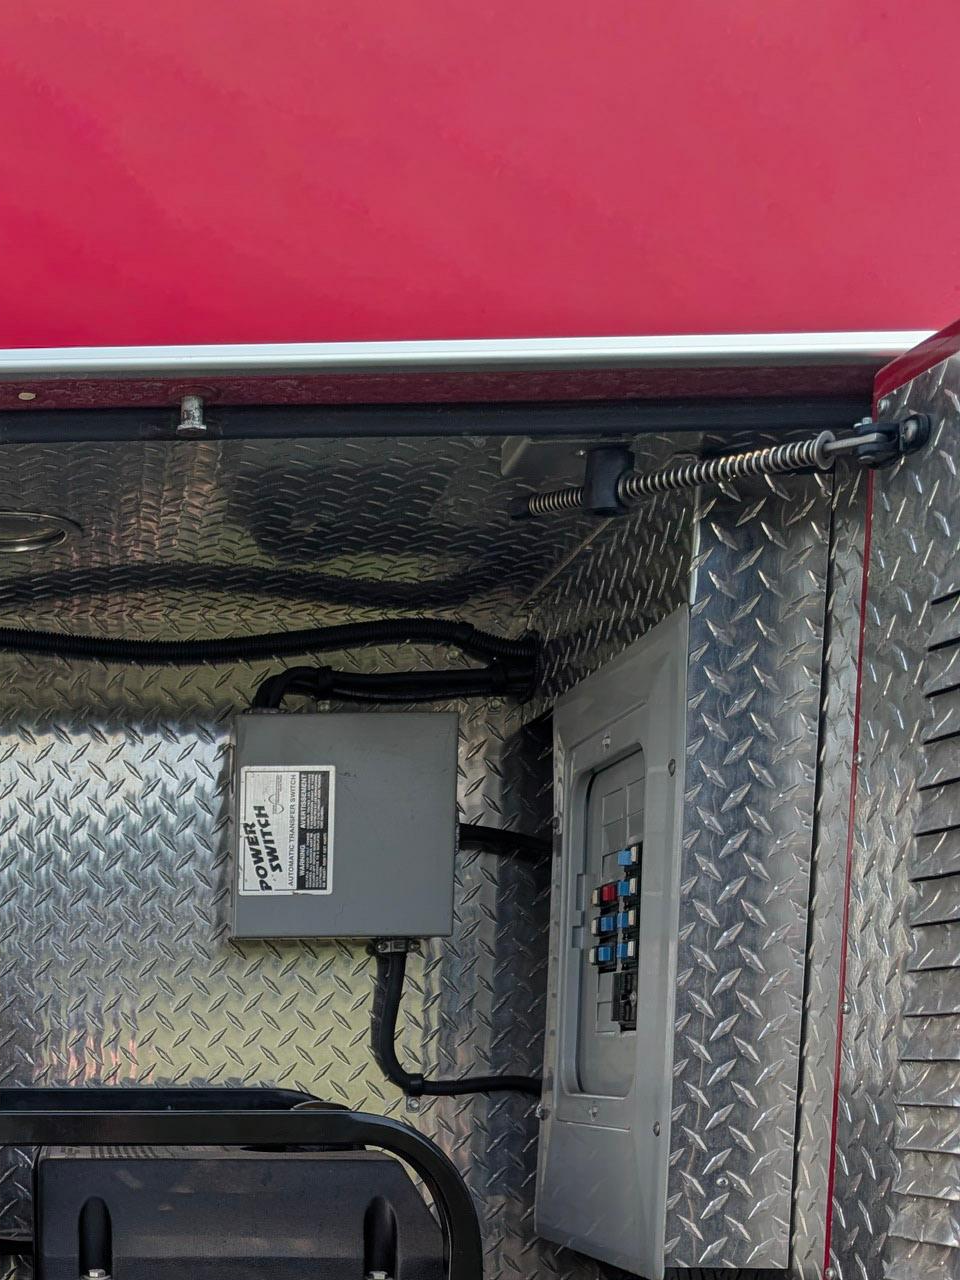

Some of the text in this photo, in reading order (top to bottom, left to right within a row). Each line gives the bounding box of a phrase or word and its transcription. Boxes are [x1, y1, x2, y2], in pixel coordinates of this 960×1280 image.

[289, 805, 297, 843] TRANSFER
[299, 774, 307, 829] AVERTISSEMENT
[242, 822, 272, 891] POWER
[253, 805, 283, 873] SWITCH
[298, 845, 306, 877] WARNING
[288, 844, 297, 887] AUTOMATIC
